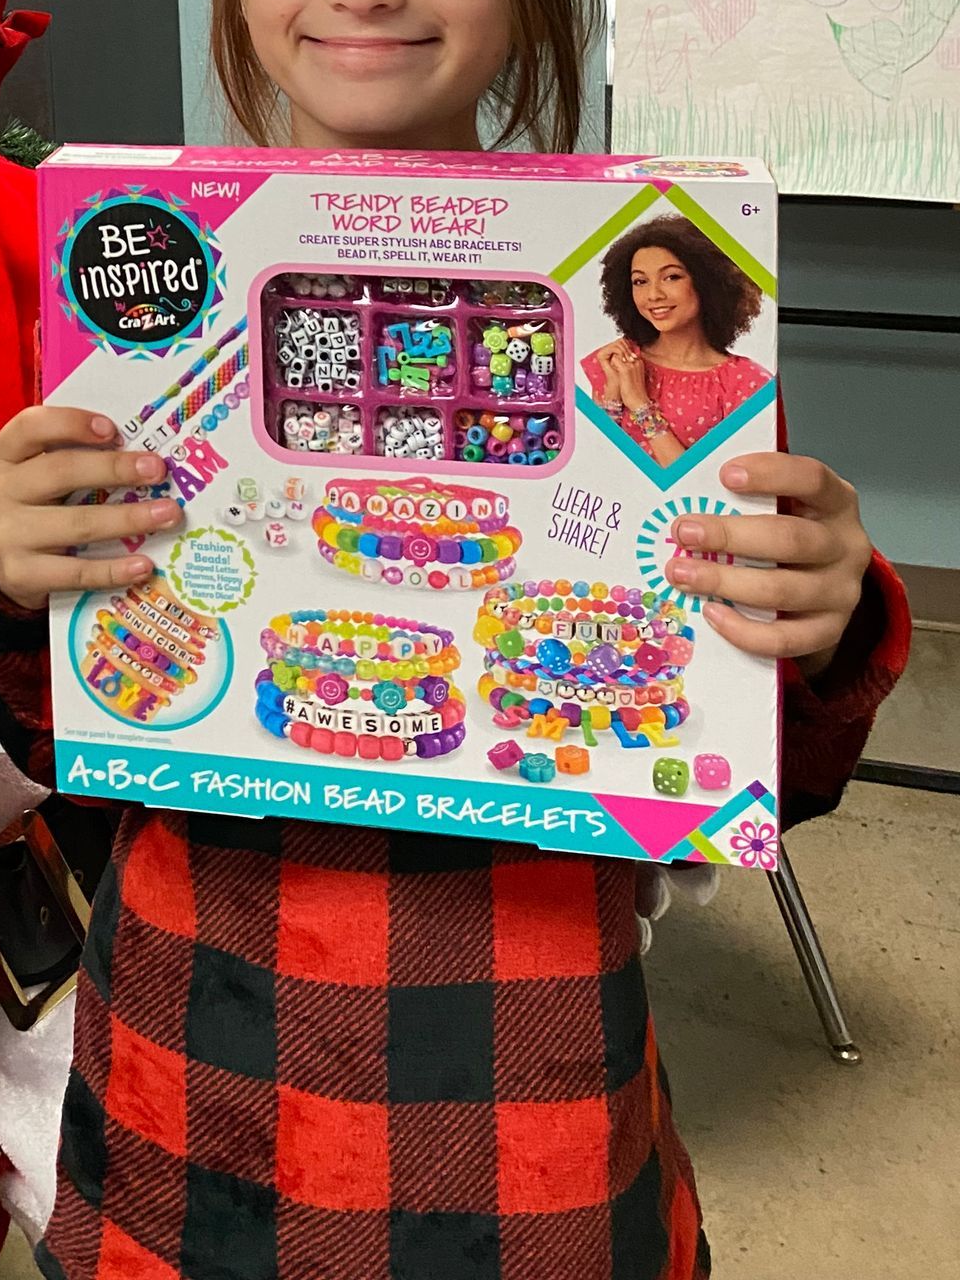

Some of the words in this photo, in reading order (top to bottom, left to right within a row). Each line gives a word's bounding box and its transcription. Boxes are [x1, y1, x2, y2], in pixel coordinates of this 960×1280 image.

[310, 160, 384, 168] BEAD
[394, 161, 567, 173] BRACELETS
[191, 181, 240, 202] NEW!
[310, 193, 403, 213] TRENDY
[410, 196, 509, 216] BEADED
[741, 203, 761, 216] 6+
[332, 214, 401, 233] WORD
[410, 217, 486, 239] WEAR!
[98, 224, 151, 259] BE
[299, 234, 341, 245] CREATE
[343, 236, 380, 247] SUPER
[381, 237, 427, 249] STYLISH
[429, 239, 452, 249] ABC
[454, 240, 522, 253] BRACELETS!
[337, 248, 367, 260] BEAD
[369, 250, 382, 262] IT,
[383, 251, 417, 262] SPELL
[418, 253, 431, 264] IT,
[432, 253, 467, 264] WEAR
[468, 254, 482, 265] IT!
[329, 491, 506, 518] #AMAZING
[552, 482, 603, 522] WEAR
[606, 502, 622, 530] &
[191, 540, 233, 552] Fashion
[548, 513, 610, 559] SHARE!
[194, 553, 230, 565] Beads!
[216, 566, 239, 574] Letter
[140, 603, 189, 640] HAPPY
[555, 623, 620, 641] FUN
[124, 611, 195, 664] UNICORN
[291, 629, 439, 657] HAPPY
[286, 699, 439, 733] #AWESOME
[191, 770, 311, 805] FASHION
[324, 785, 405, 815] BEAD
[417, 794, 607, 837] BRACELETS
